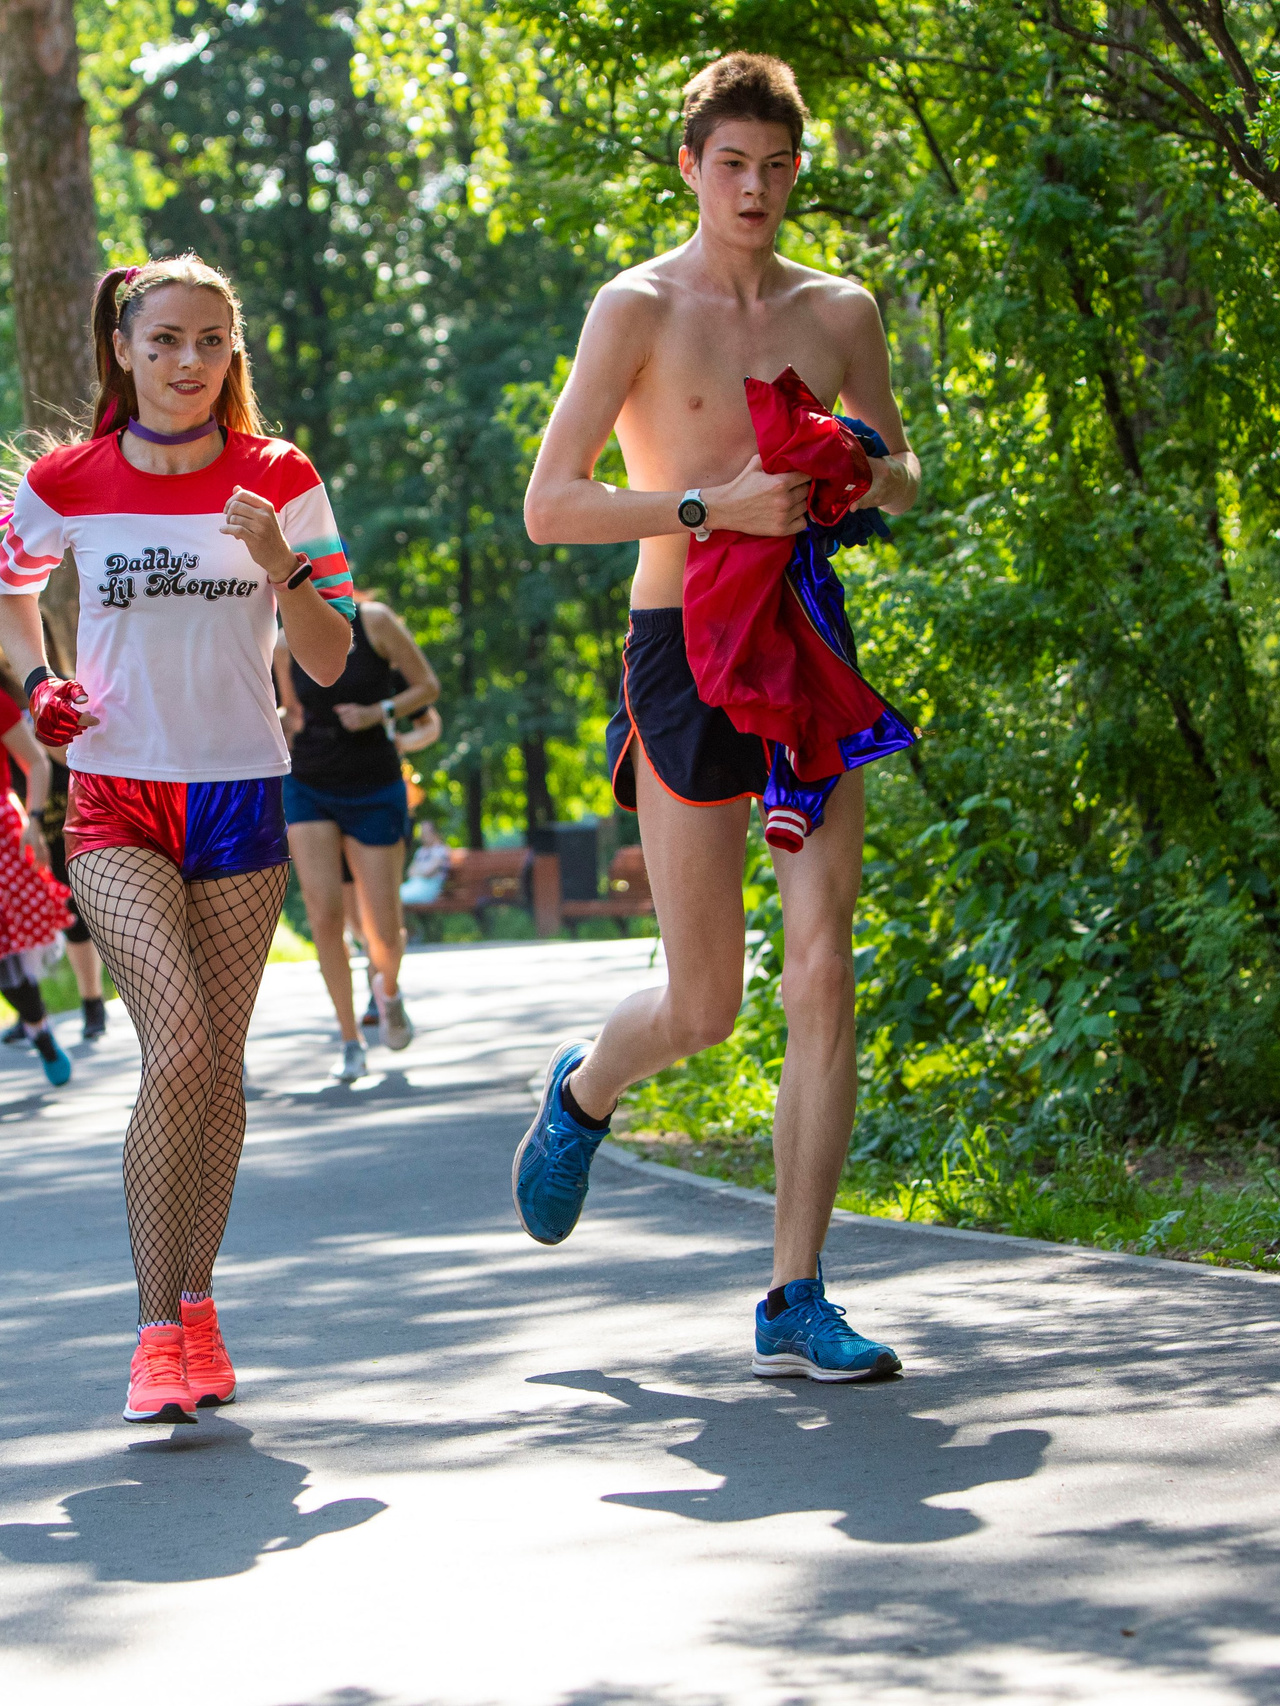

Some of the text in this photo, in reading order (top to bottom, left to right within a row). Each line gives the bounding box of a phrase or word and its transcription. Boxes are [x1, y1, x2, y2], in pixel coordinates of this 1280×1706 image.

[104, 547, 200, 577] Daddy's
[98, 571, 259, 609] Lil Monster
